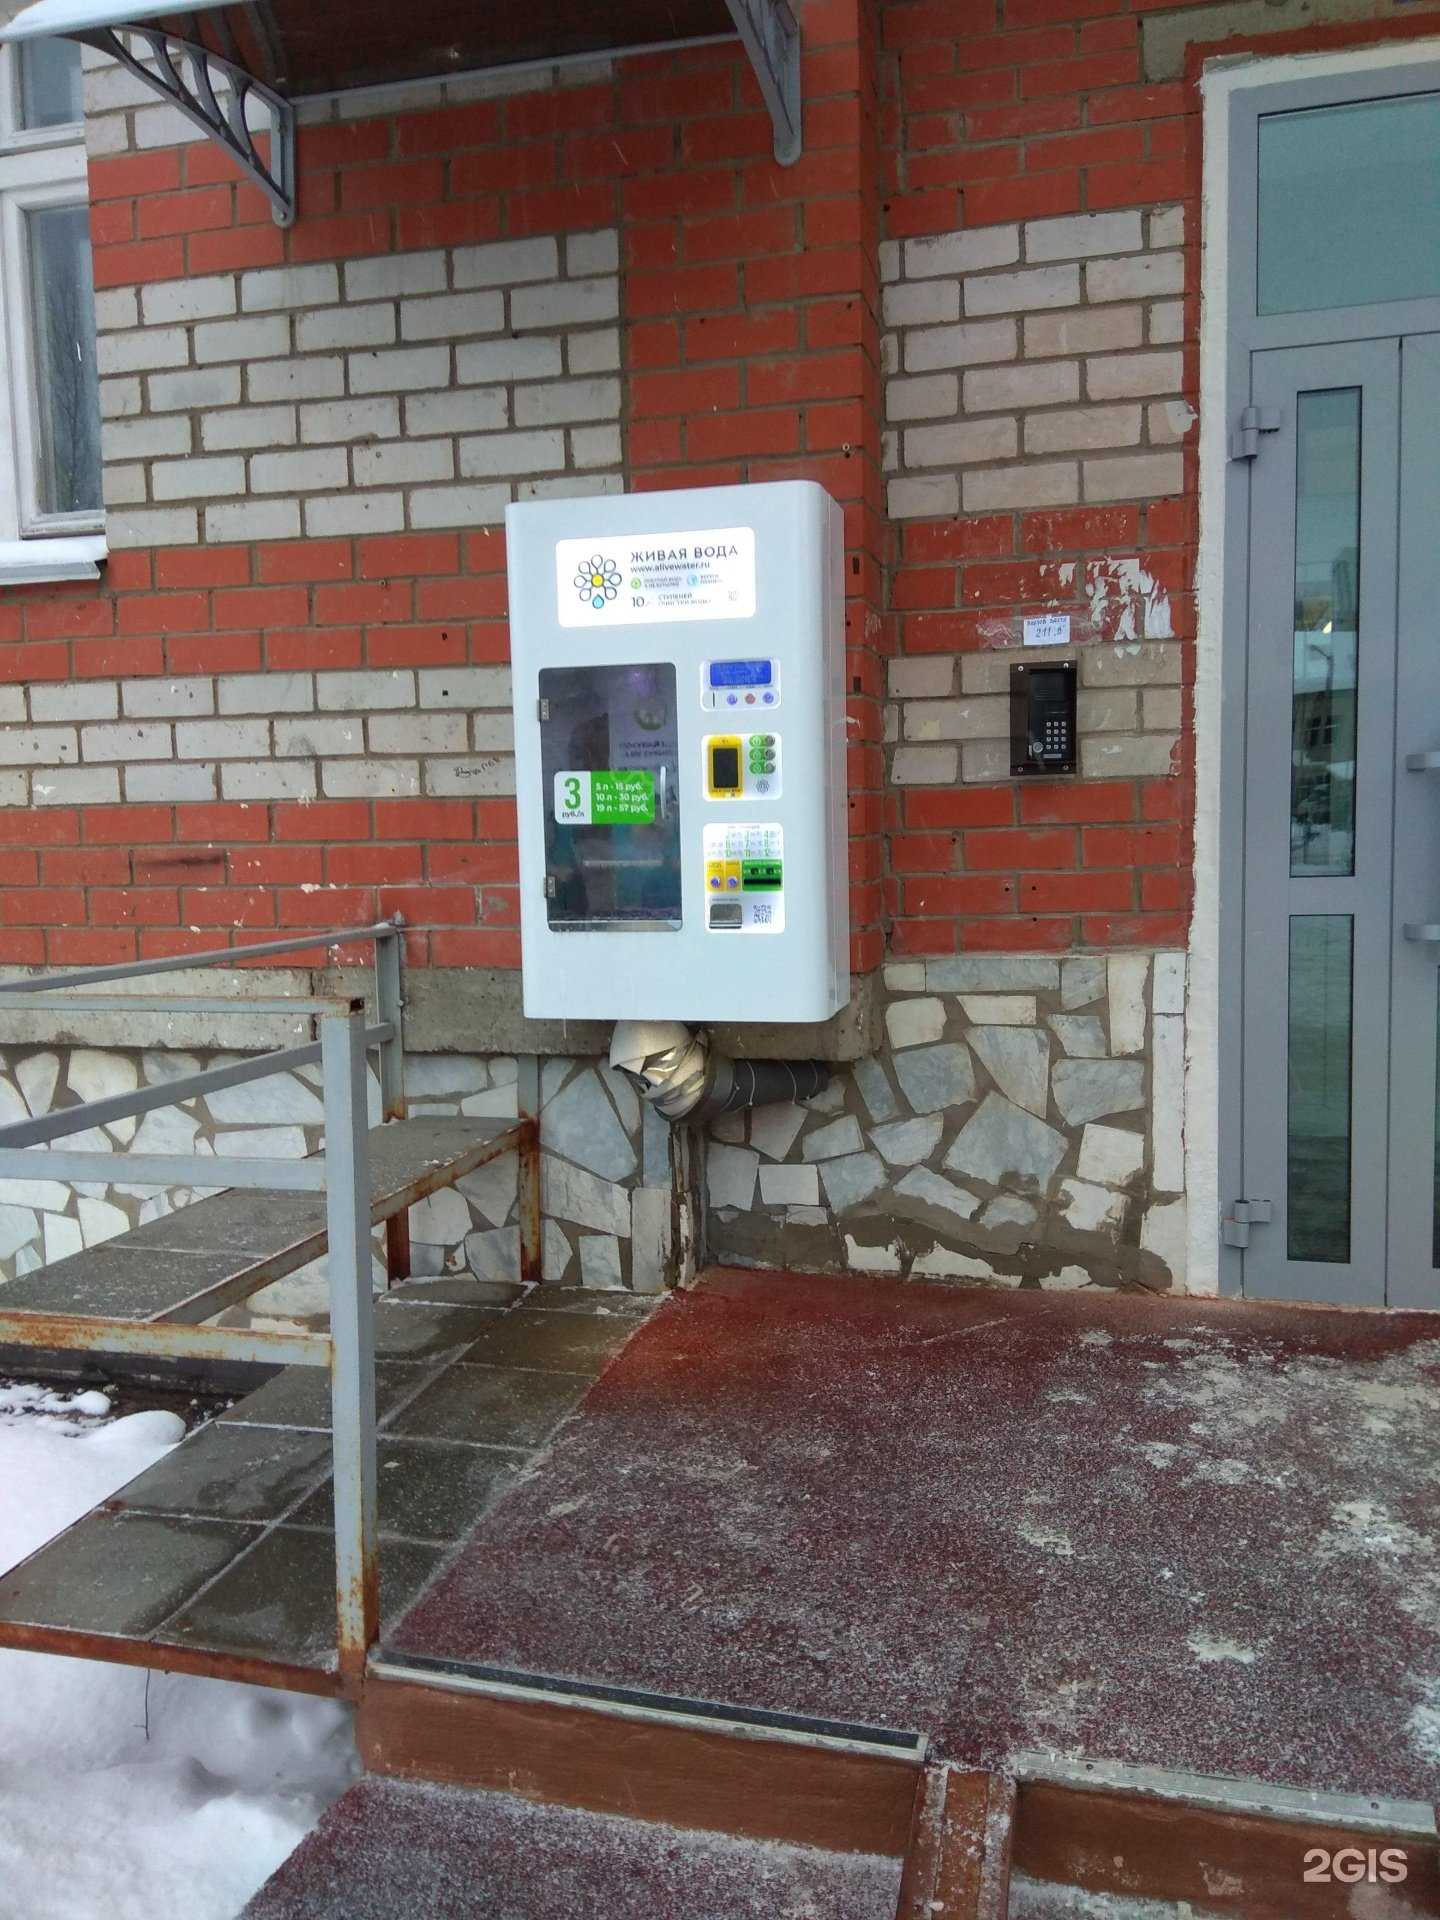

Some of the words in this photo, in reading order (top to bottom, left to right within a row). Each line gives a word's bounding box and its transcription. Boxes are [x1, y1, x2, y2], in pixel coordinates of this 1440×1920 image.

[631, 548, 688, 562] ЖИВАЯ
[694, 545, 738, 559] ВОДА
[630, 562, 710, 574] www.alivewater.ru
[565, 777, 581, 809] 3
[625, 783, 643, 792] руб.
[596, 793, 604, 801] 10
[632, 793, 649, 803] руб.
[631, 804, 648, 813] руб.
